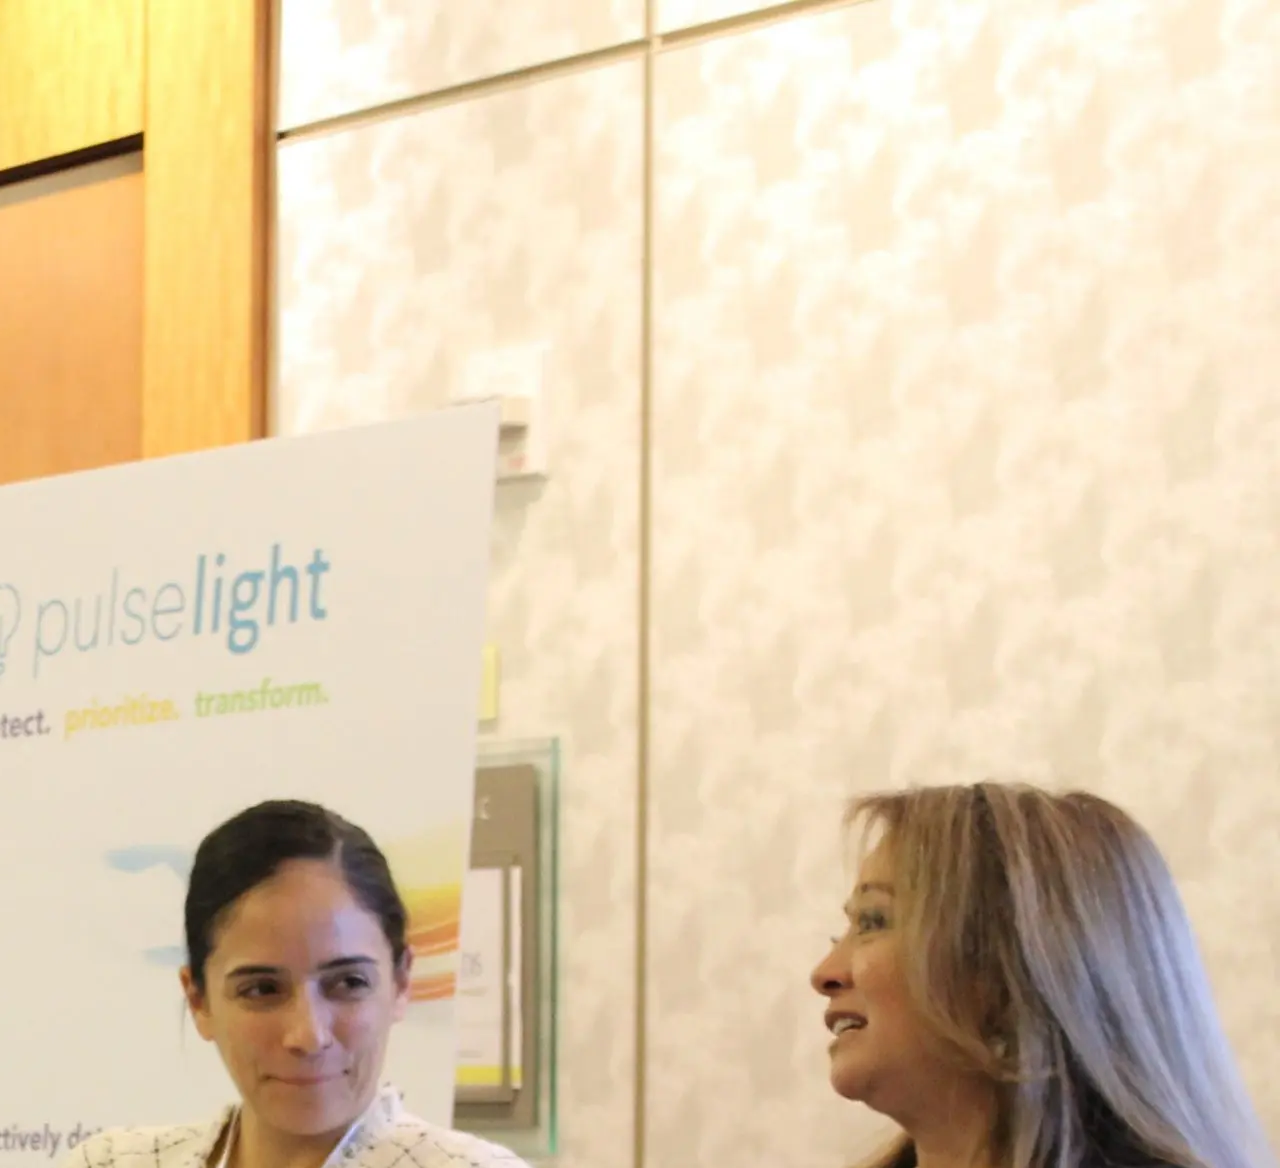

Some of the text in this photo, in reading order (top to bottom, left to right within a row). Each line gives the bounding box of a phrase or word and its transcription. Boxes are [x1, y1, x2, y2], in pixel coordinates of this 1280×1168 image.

[33, 542, 330, 681] pulselight
[64, 691, 181, 741] prioritize.
[194, 676, 330, 718] transform.
